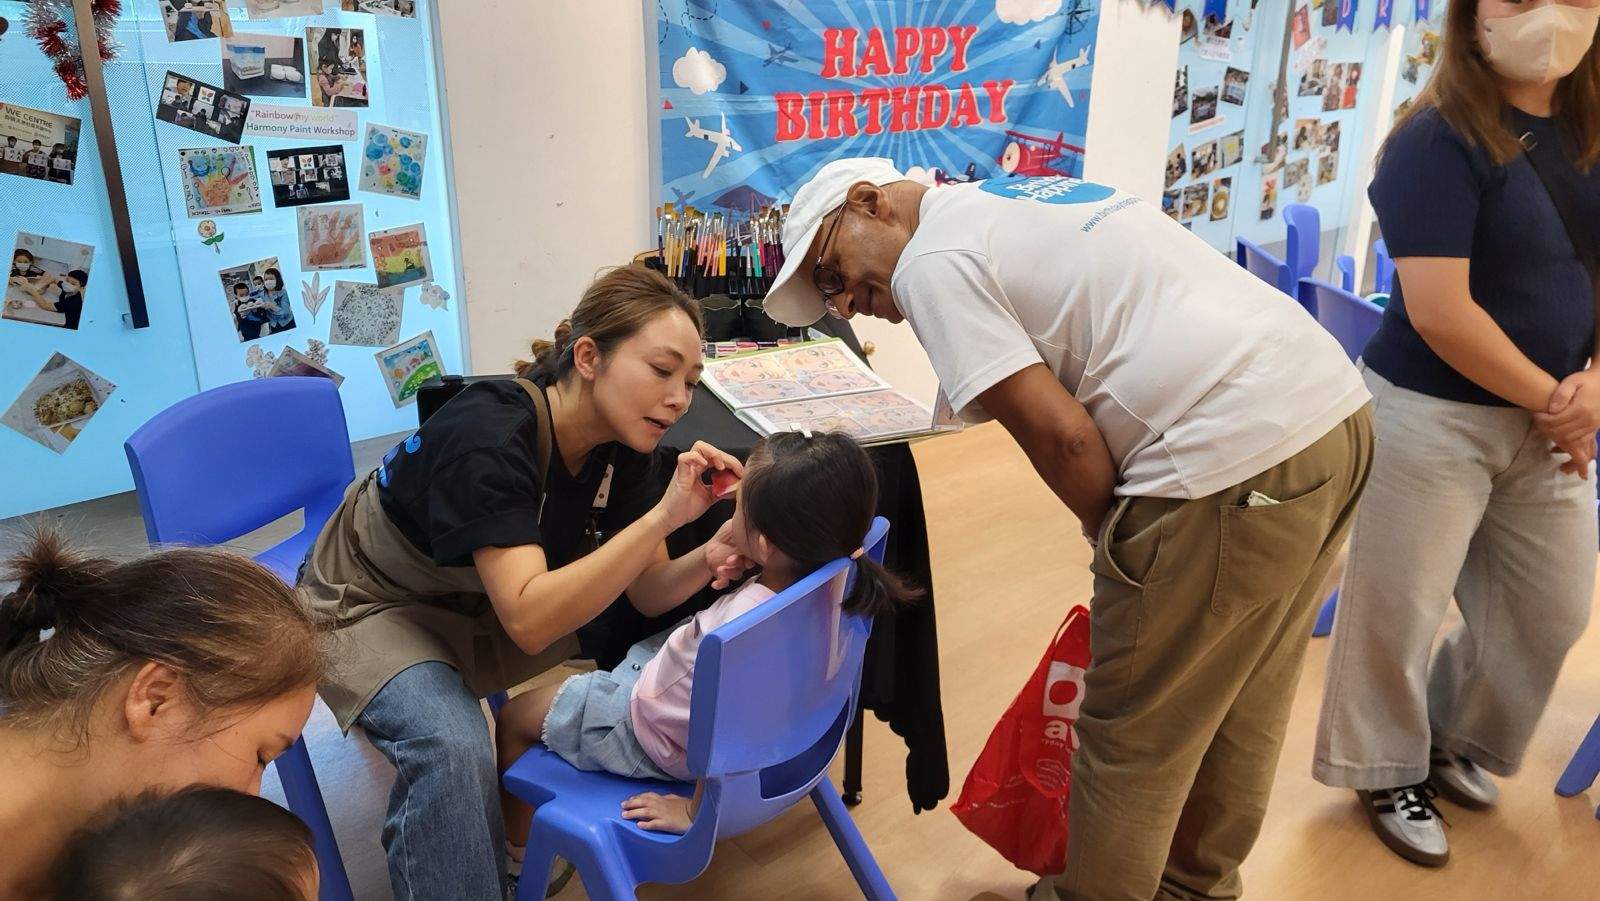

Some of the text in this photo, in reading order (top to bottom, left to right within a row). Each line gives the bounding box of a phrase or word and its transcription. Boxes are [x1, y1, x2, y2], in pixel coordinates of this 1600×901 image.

[821, 25, 979, 79] HAPPY
[5, 106, 21, 118] WE
[23, 113, 53, 129] CENTRE
[246, 123, 356, 137] Harmony Paint Workshop
[774, 80, 1016, 143] BIRTHDAY
